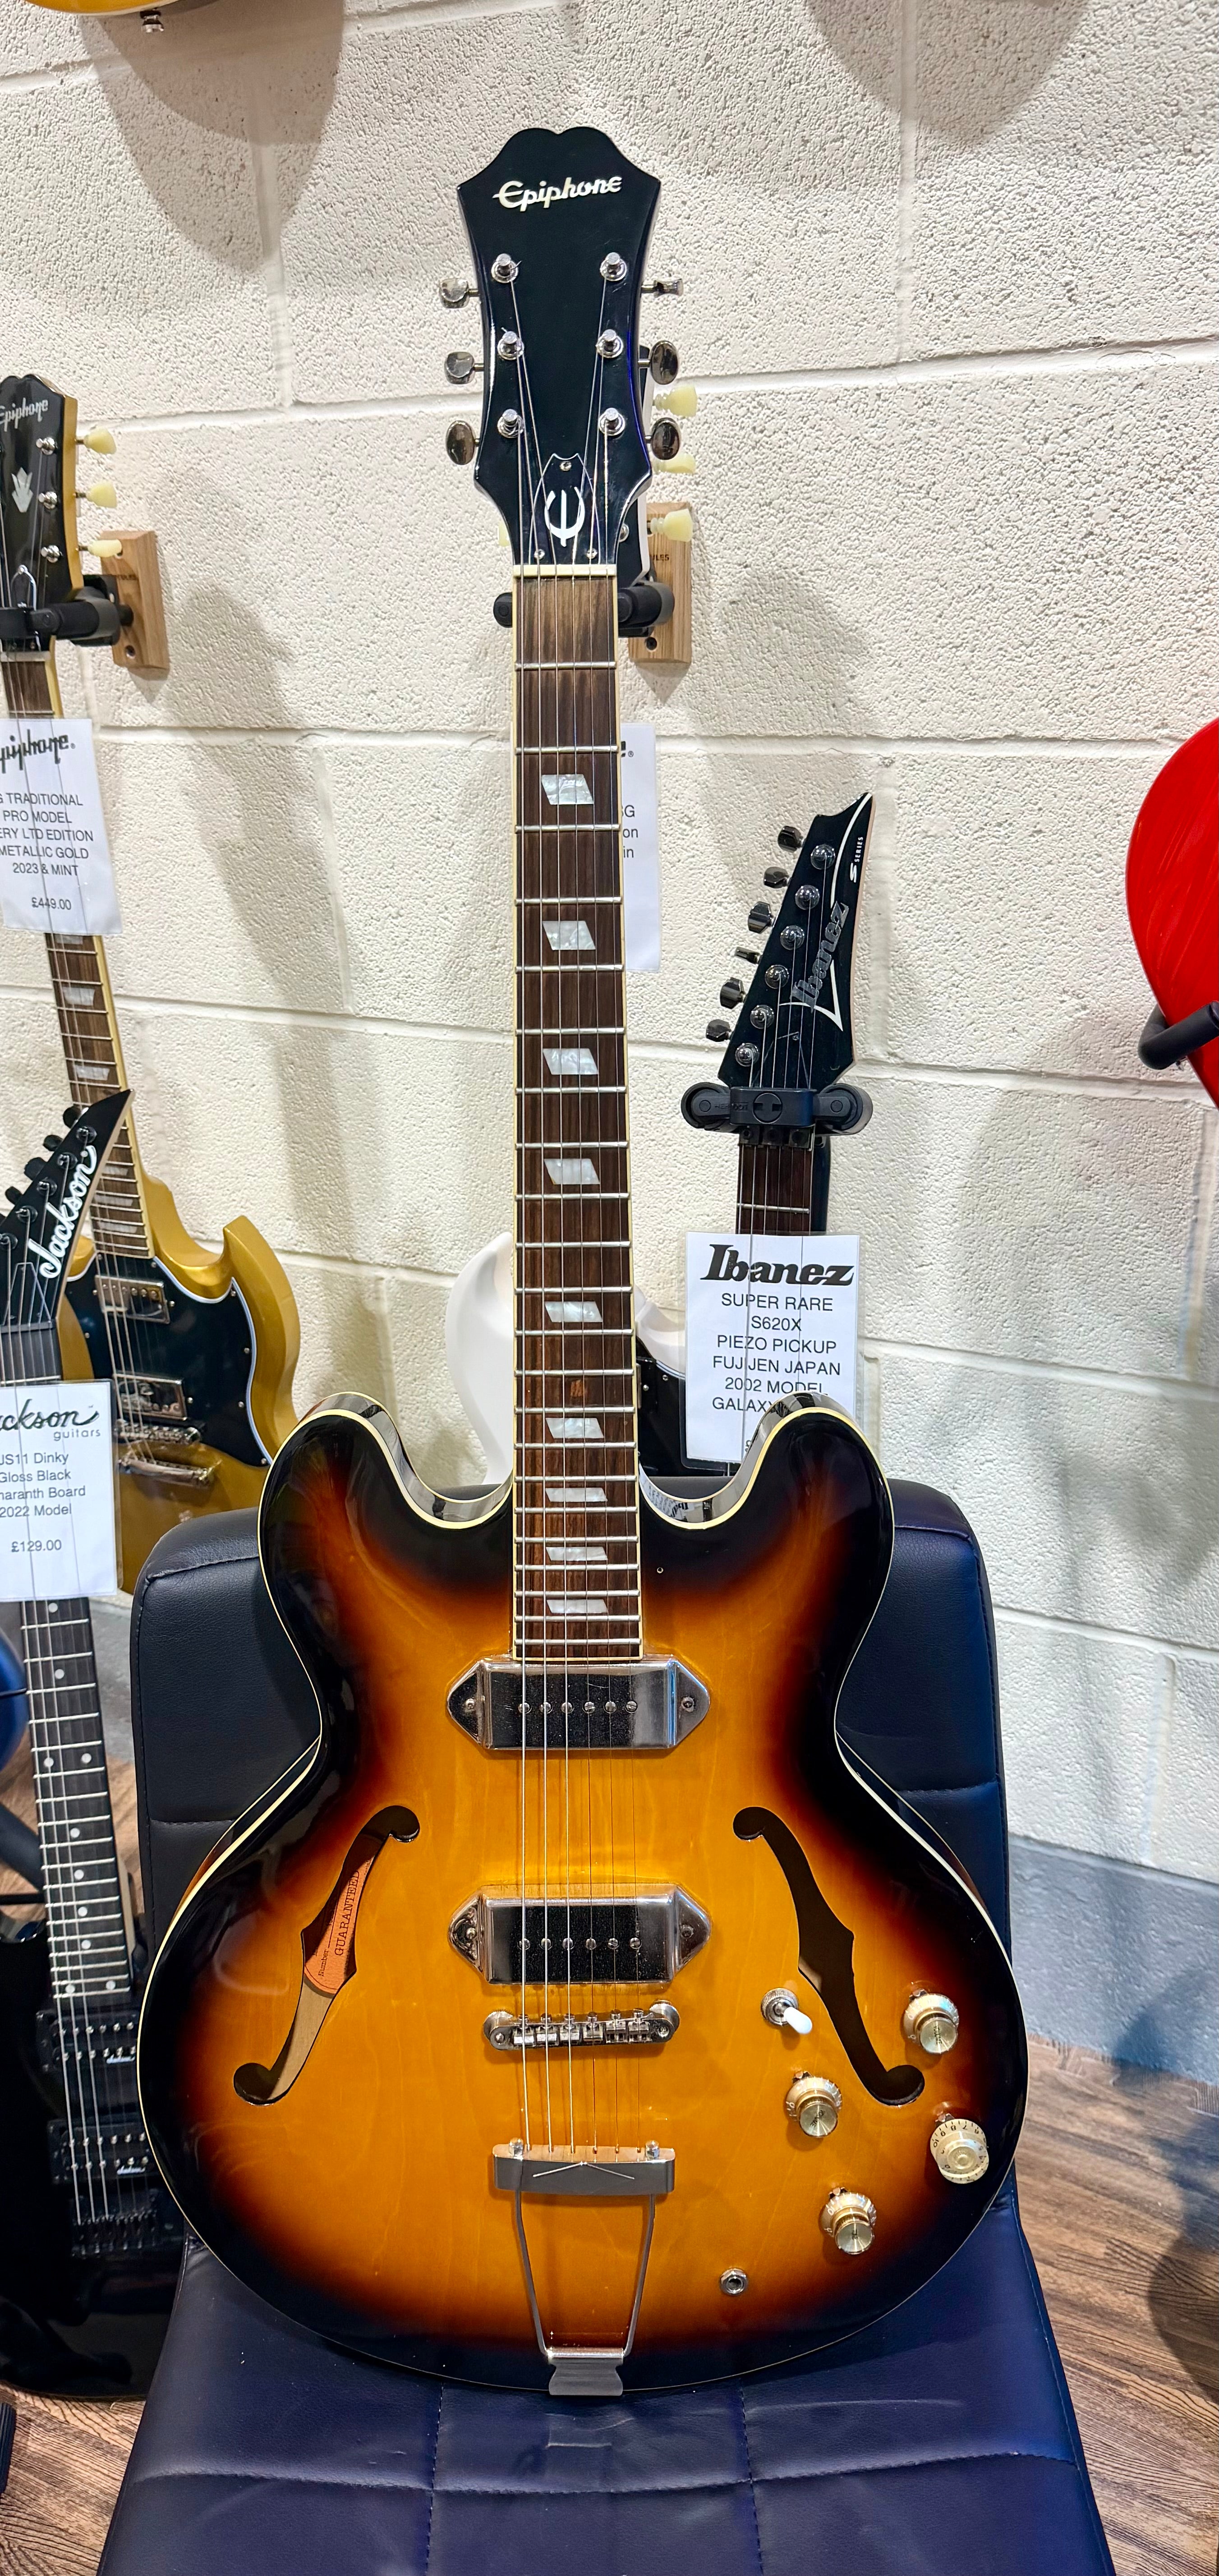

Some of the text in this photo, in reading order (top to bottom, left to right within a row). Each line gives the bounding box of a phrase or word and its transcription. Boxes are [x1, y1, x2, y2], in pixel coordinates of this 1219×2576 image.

[492, 176, 622, 212] Epiphone
[6, 793, 83, 805] TRADITIONAL
[3, 810, 72, 823] PRO MODEL
[23, 828, 43, 839] LTD
[46, 829, 93, 841] EDITION
[0, 845, 89, 859] METALLIC GOLD
[854, 837, 863, 862] SERIES
[13, 863, 78, 875] 2023 & MINT
[32, 897, 71, 911] £449.00
[790, 901, 849, 1013] Ibanez
[28, 1145, 97, 1278] Jackson
[700, 1244, 854, 1286] Ibanez
[722, 1293, 833, 1311] SUPER RARE
[751, 1316, 802, 1331] S620X
[718, 1334, 837, 1353] PIEZO PICKUP
[785, 1361, 840, 1375] JAPAN
[725, 1378, 828, 1395] 2002 MODEL
[712, 1396, 772, 1412] GALAX
[0, 1399, 100, 1431] ckson
[53, 1428, 101, 1441] guitars
[0, 1452, 69, 1465] JS11 Dinky
[0, 1468, 71, 1483] Gloss Black
[48, 1485, 86, 1498] Board
[0, 1503, 72, 1518] 2022 Model
[11, 1539, 61, 1553] £129.00
[334, 1870, 359, 1956] GUARANTEED
